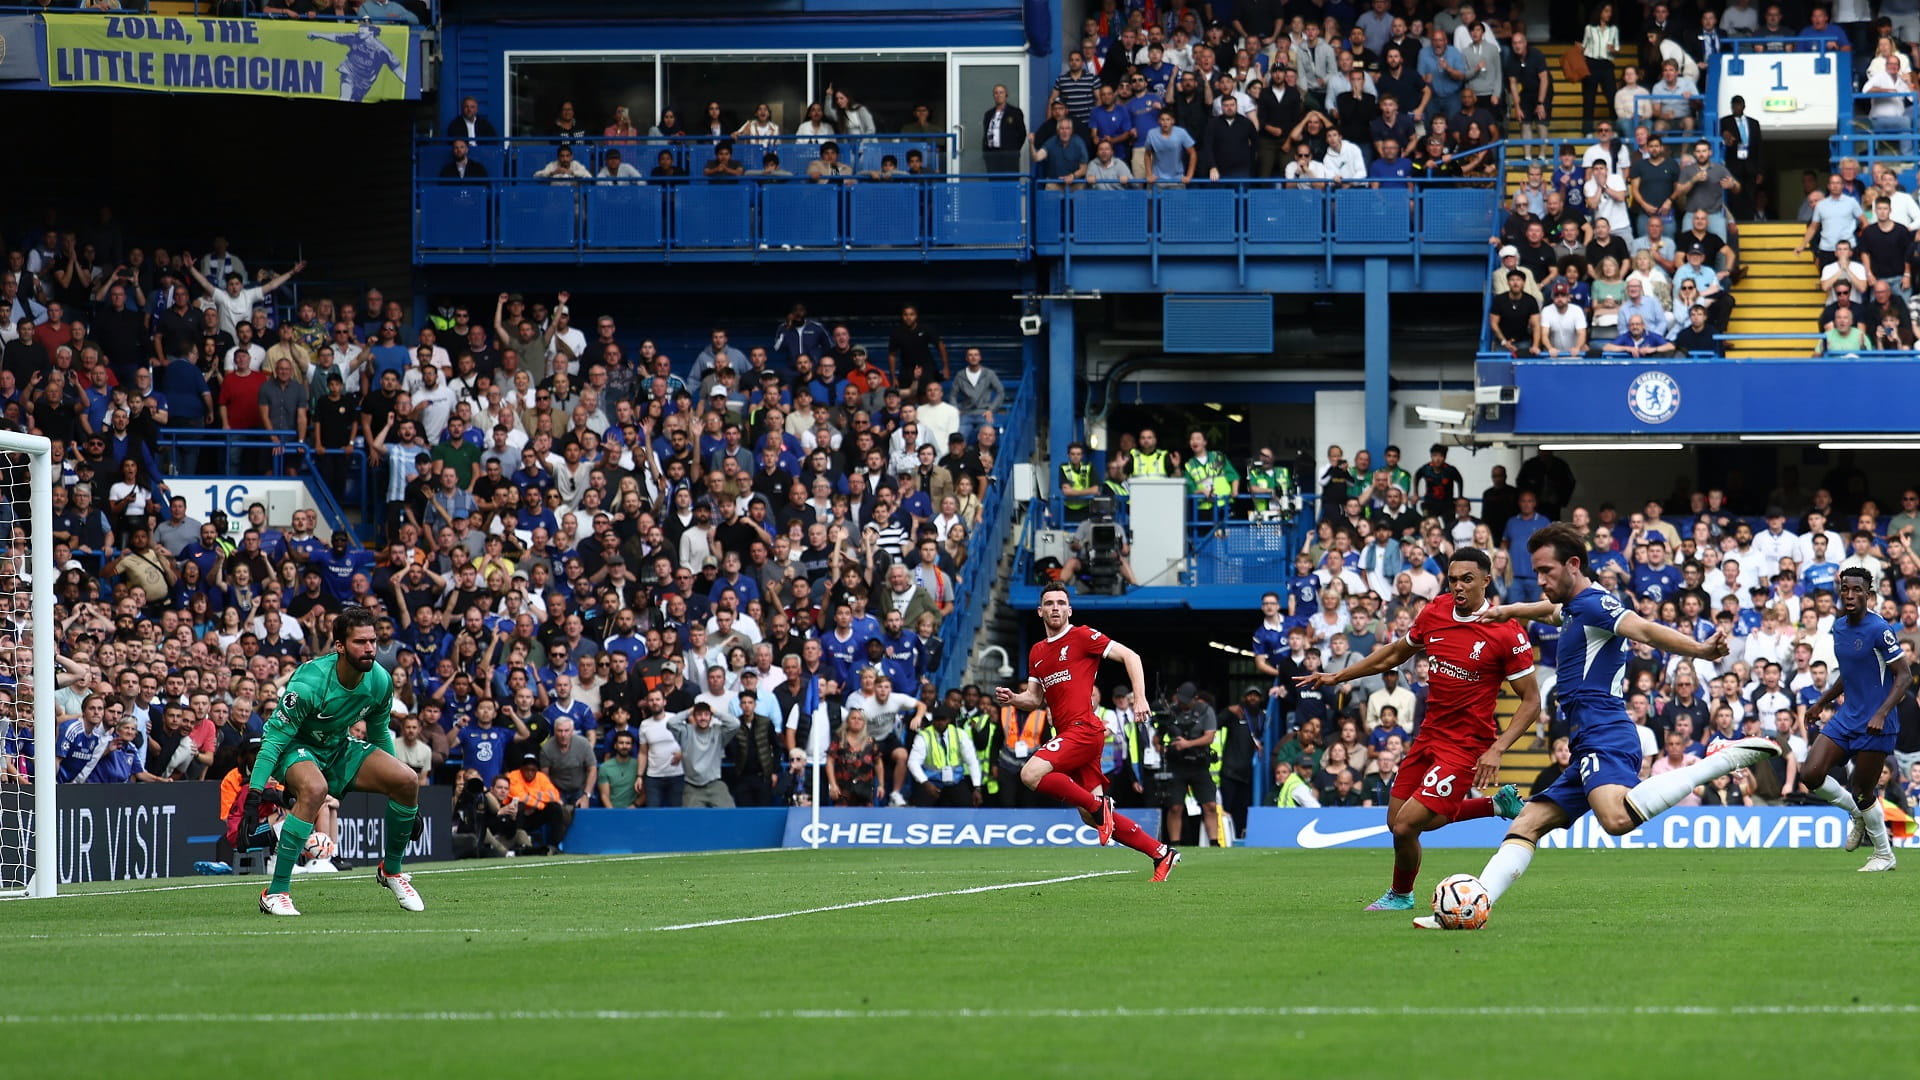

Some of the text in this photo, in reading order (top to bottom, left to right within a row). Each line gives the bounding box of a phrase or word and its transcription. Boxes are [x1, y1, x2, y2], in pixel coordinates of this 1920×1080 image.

[105, 17, 260, 45] ZOLA, THE
[57, 48, 325, 94] LITTLE MAGICIAN
[1770, 61, 1789, 91] 1
[204, 484, 249, 518] 16
[1423, 765, 1456, 797] 66
[1580, 752, 1600, 778] 21
[106, 805, 176, 881] VISIT
[336, 817, 364, 859] RIDE
[367, 818, 379, 847] OF
[801, 823, 1115, 847] CHELSEAFC.CO
